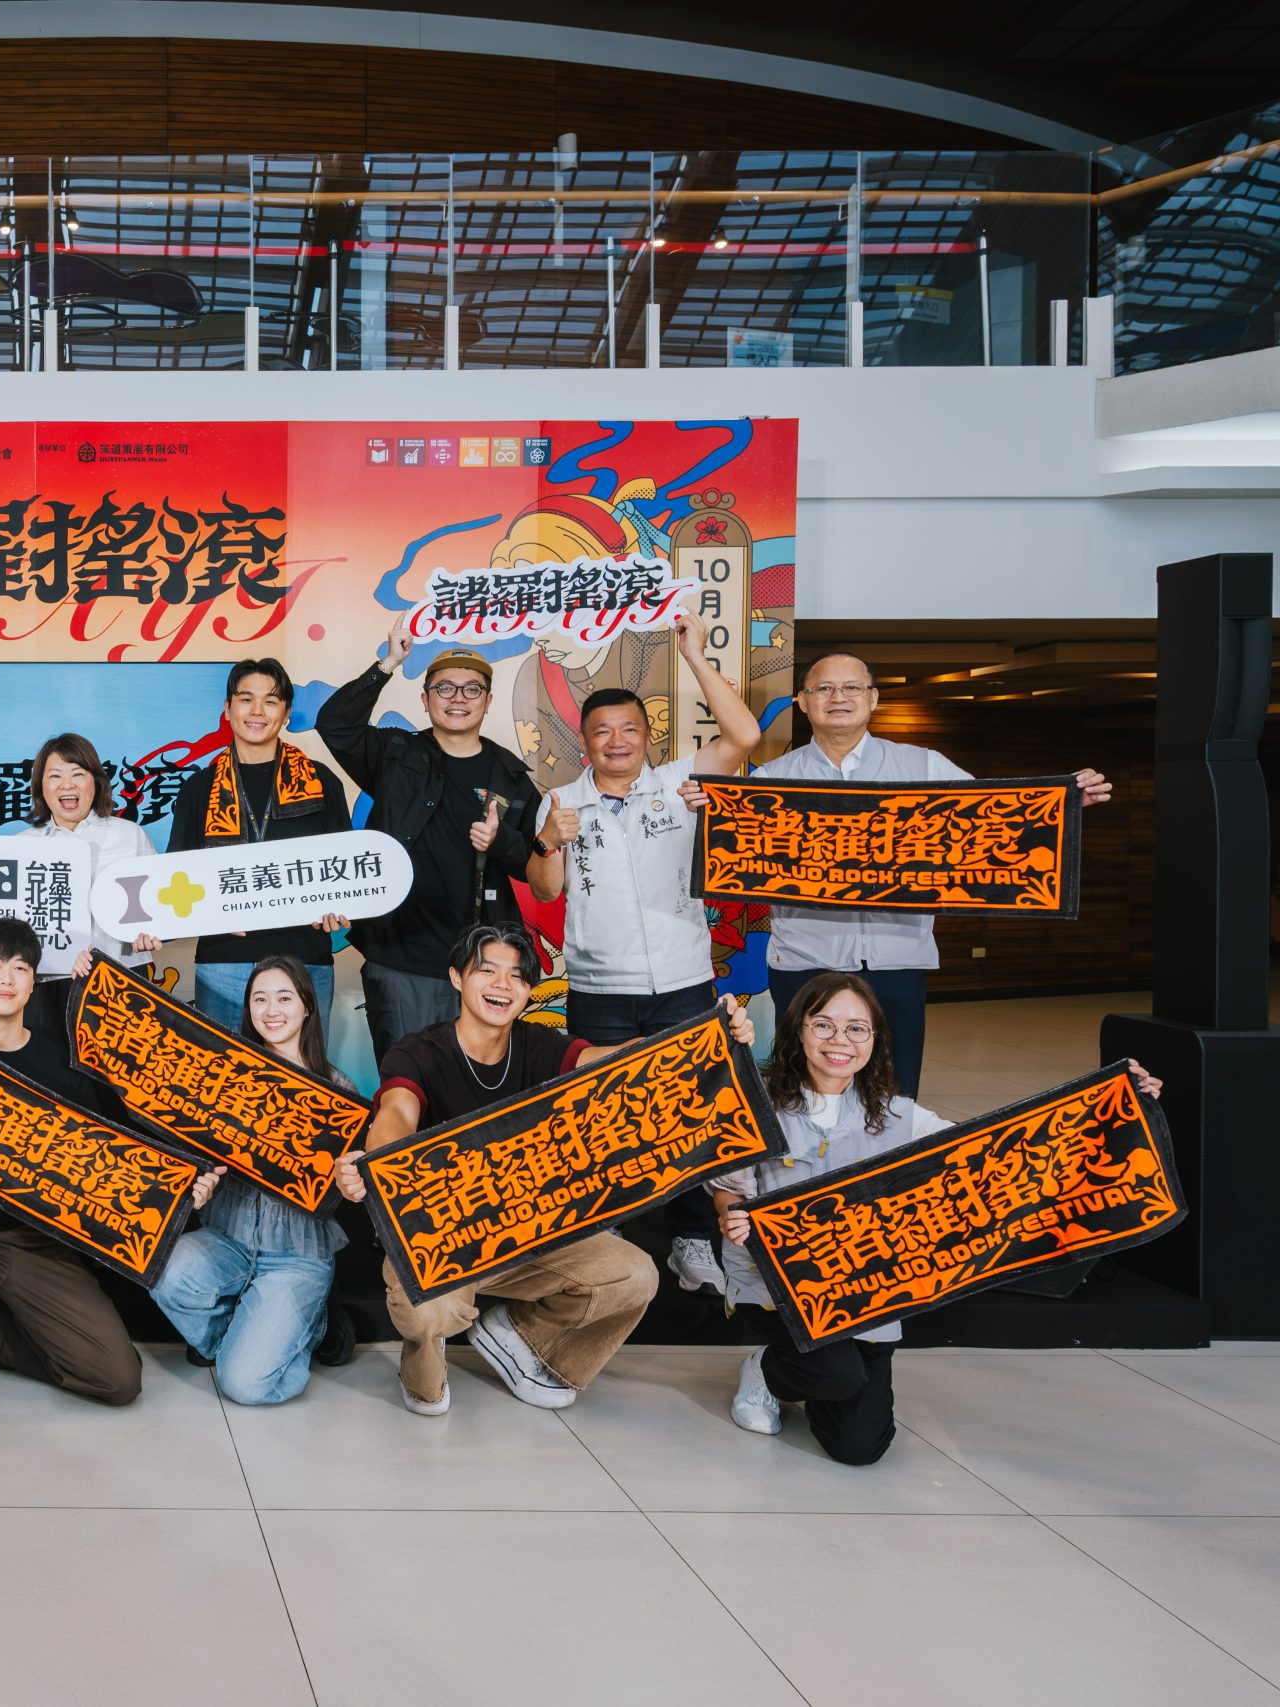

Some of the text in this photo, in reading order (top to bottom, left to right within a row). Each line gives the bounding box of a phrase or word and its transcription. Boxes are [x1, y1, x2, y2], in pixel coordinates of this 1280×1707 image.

[99, 444, 189, 455] 笨道策展有限公司
[590, 819, 604, 848] 議員
[218, 850, 383, 895] 嘉義市政府
[572, 834, 596, 896] 陳家平
[733, 859, 1029, 885] JHULUO ROCK FESTIVAL
[49, 862, 72, 950] 音樂中心
[222, 886, 387, 912] CHIAYI CITY GOVERNMENT
[95, 1044, 305, 1178] HULUO ROCK FESTIVAL
[37, 1180, 134, 1236] FESTIVAL
[440, 1120, 724, 1255] JHULUO ROCK FESTIVAL
[827, 1184, 1145, 1302] JHULUO ROCK FESTIVAL
